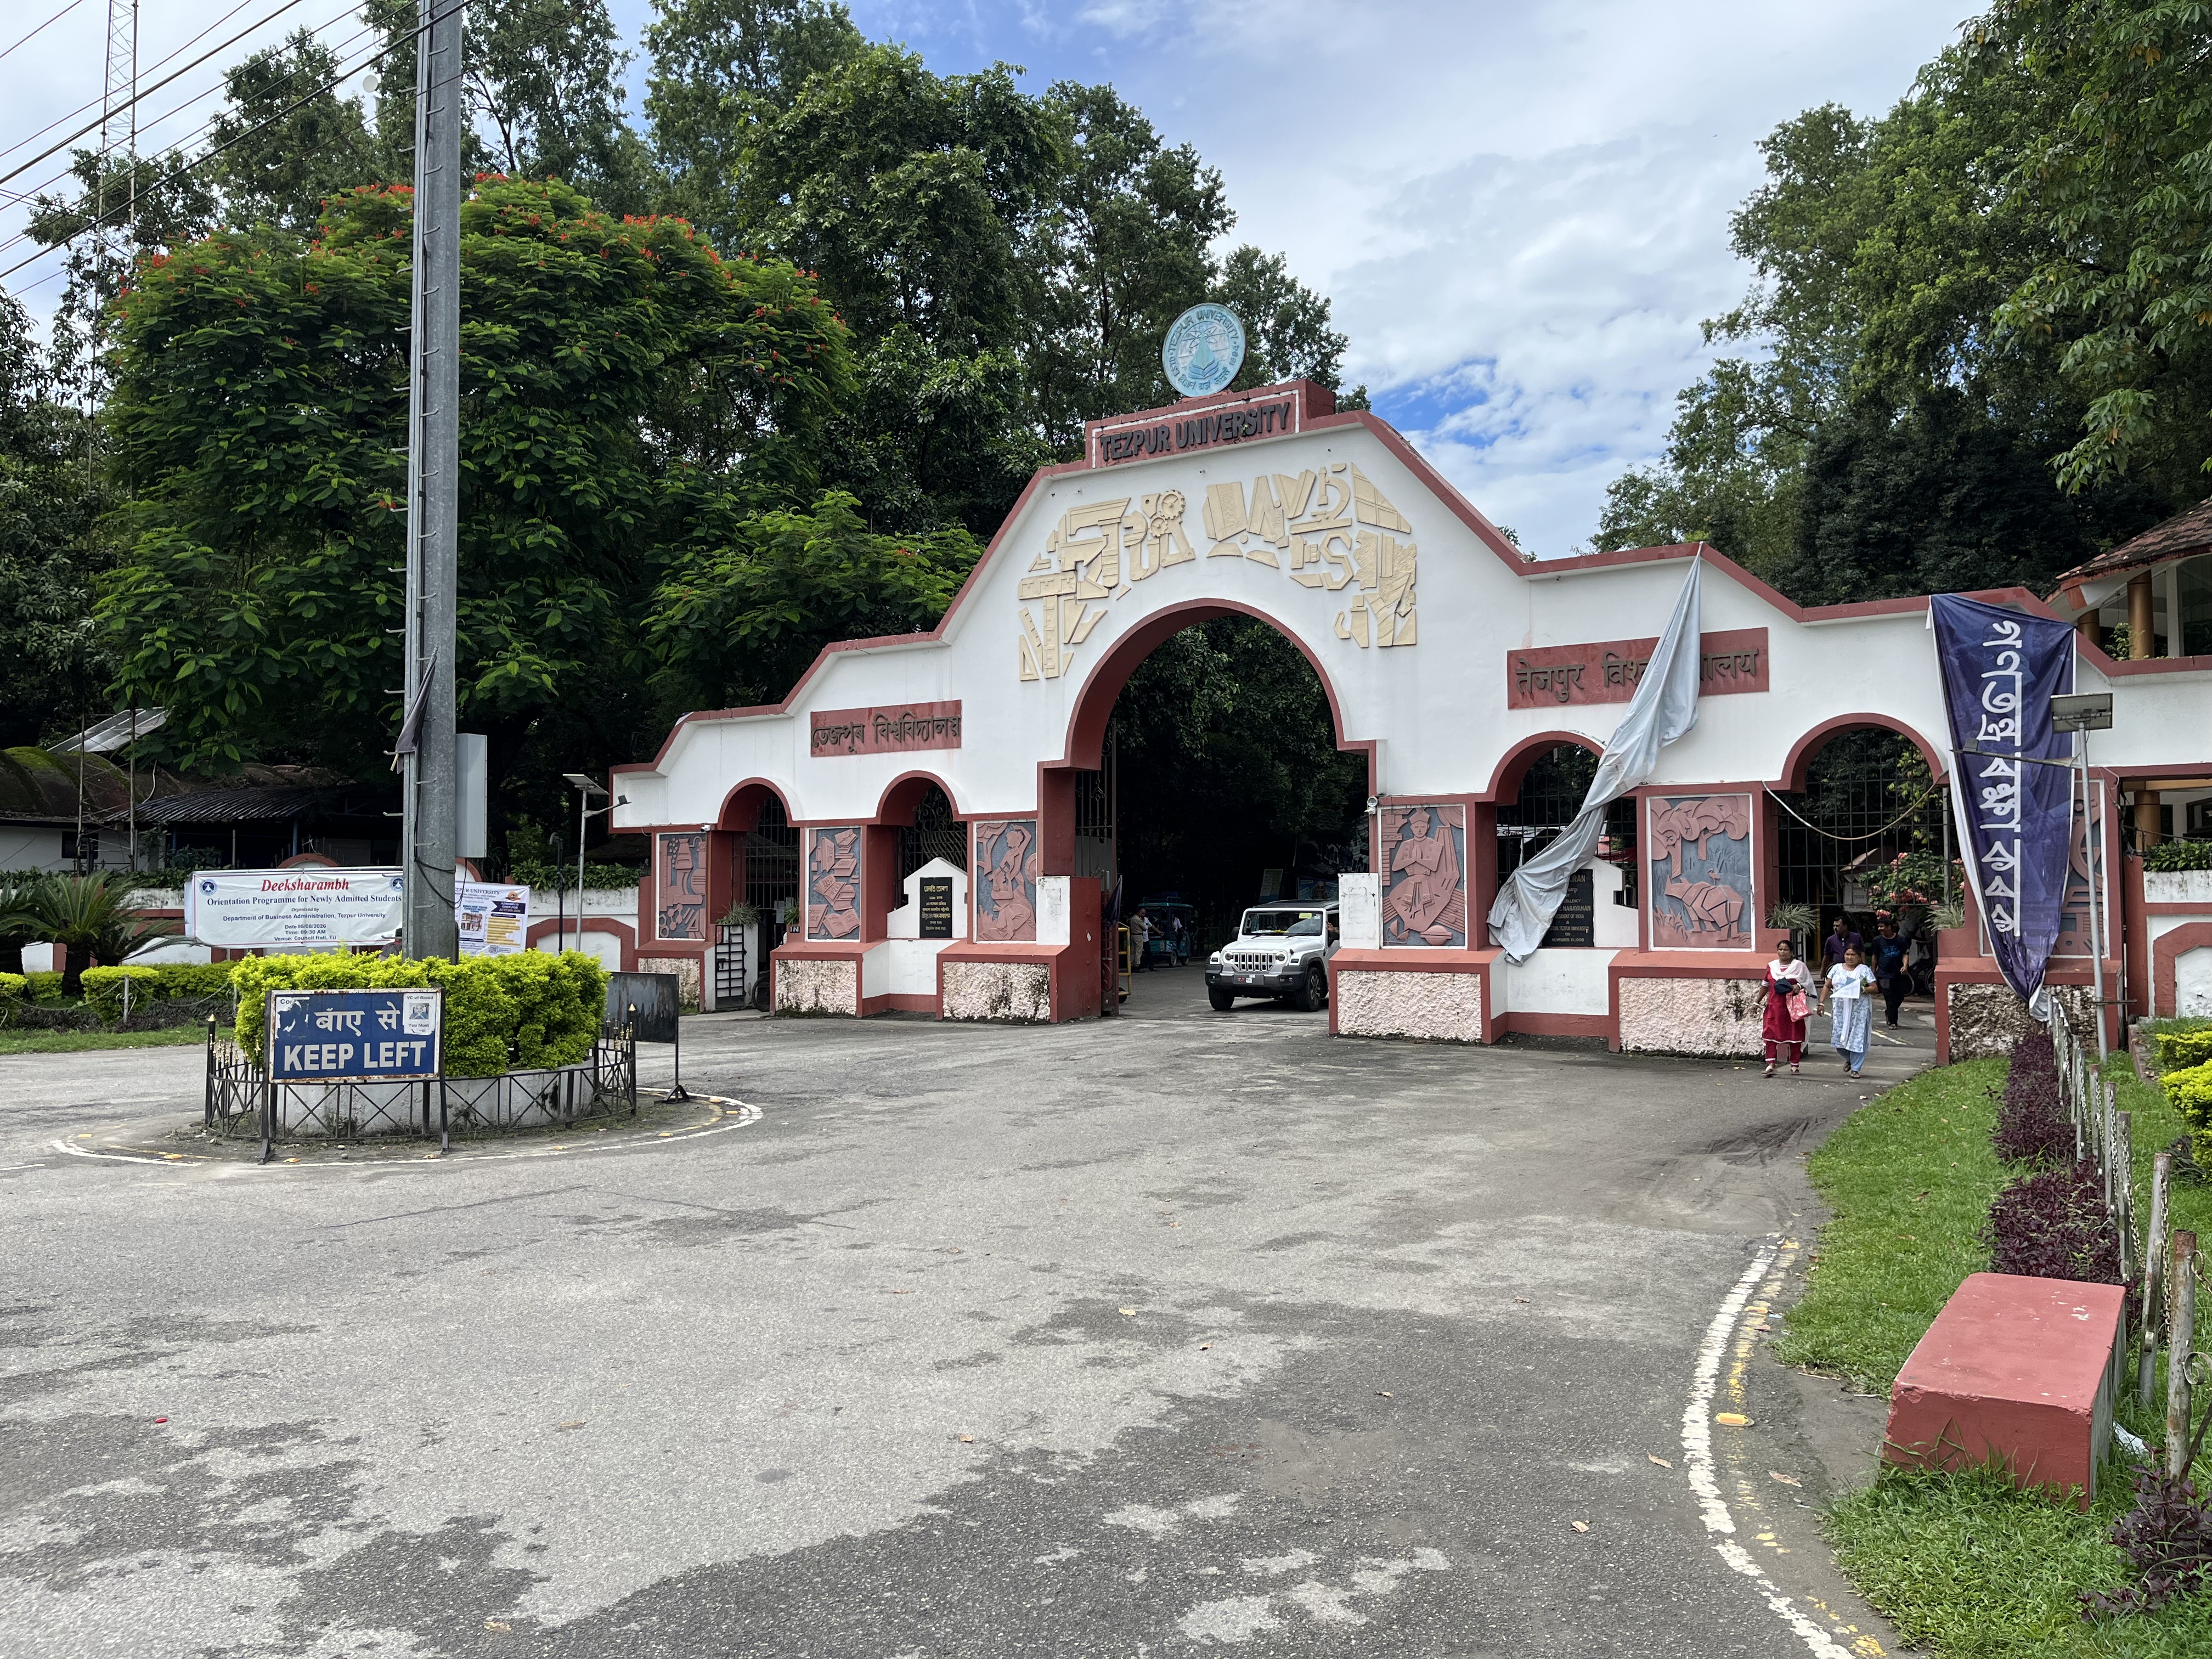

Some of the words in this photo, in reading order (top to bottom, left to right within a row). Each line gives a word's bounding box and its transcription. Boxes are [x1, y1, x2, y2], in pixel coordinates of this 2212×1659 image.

[1167, 314, 1194, 352] TEZPUR
[1197, 309, 1239, 339] UNIVERSITY
[1100, 425, 1170, 461] TEZPUR
[1176, 401, 1290, 448] UNIVERSITY
[1515, 658, 1585, 703] तेजपुर
[811, 721, 865, 753] তেজপুৰ
[873, 711, 962, 743] বিশ্ববিদ্যালয়
[207, 897, 250, 906] Orientation
[252, 896, 296, 906] Programme
[310, 895, 332, 904] Newly
[261, 878, 349, 891] Deeksharambh
[1981, 839, 2021, 936] কৰক
[375, 1001, 401, 1030] से
[284, 1043, 354, 1071] KEEP
[364, 1041, 426, 1069] LEFT
